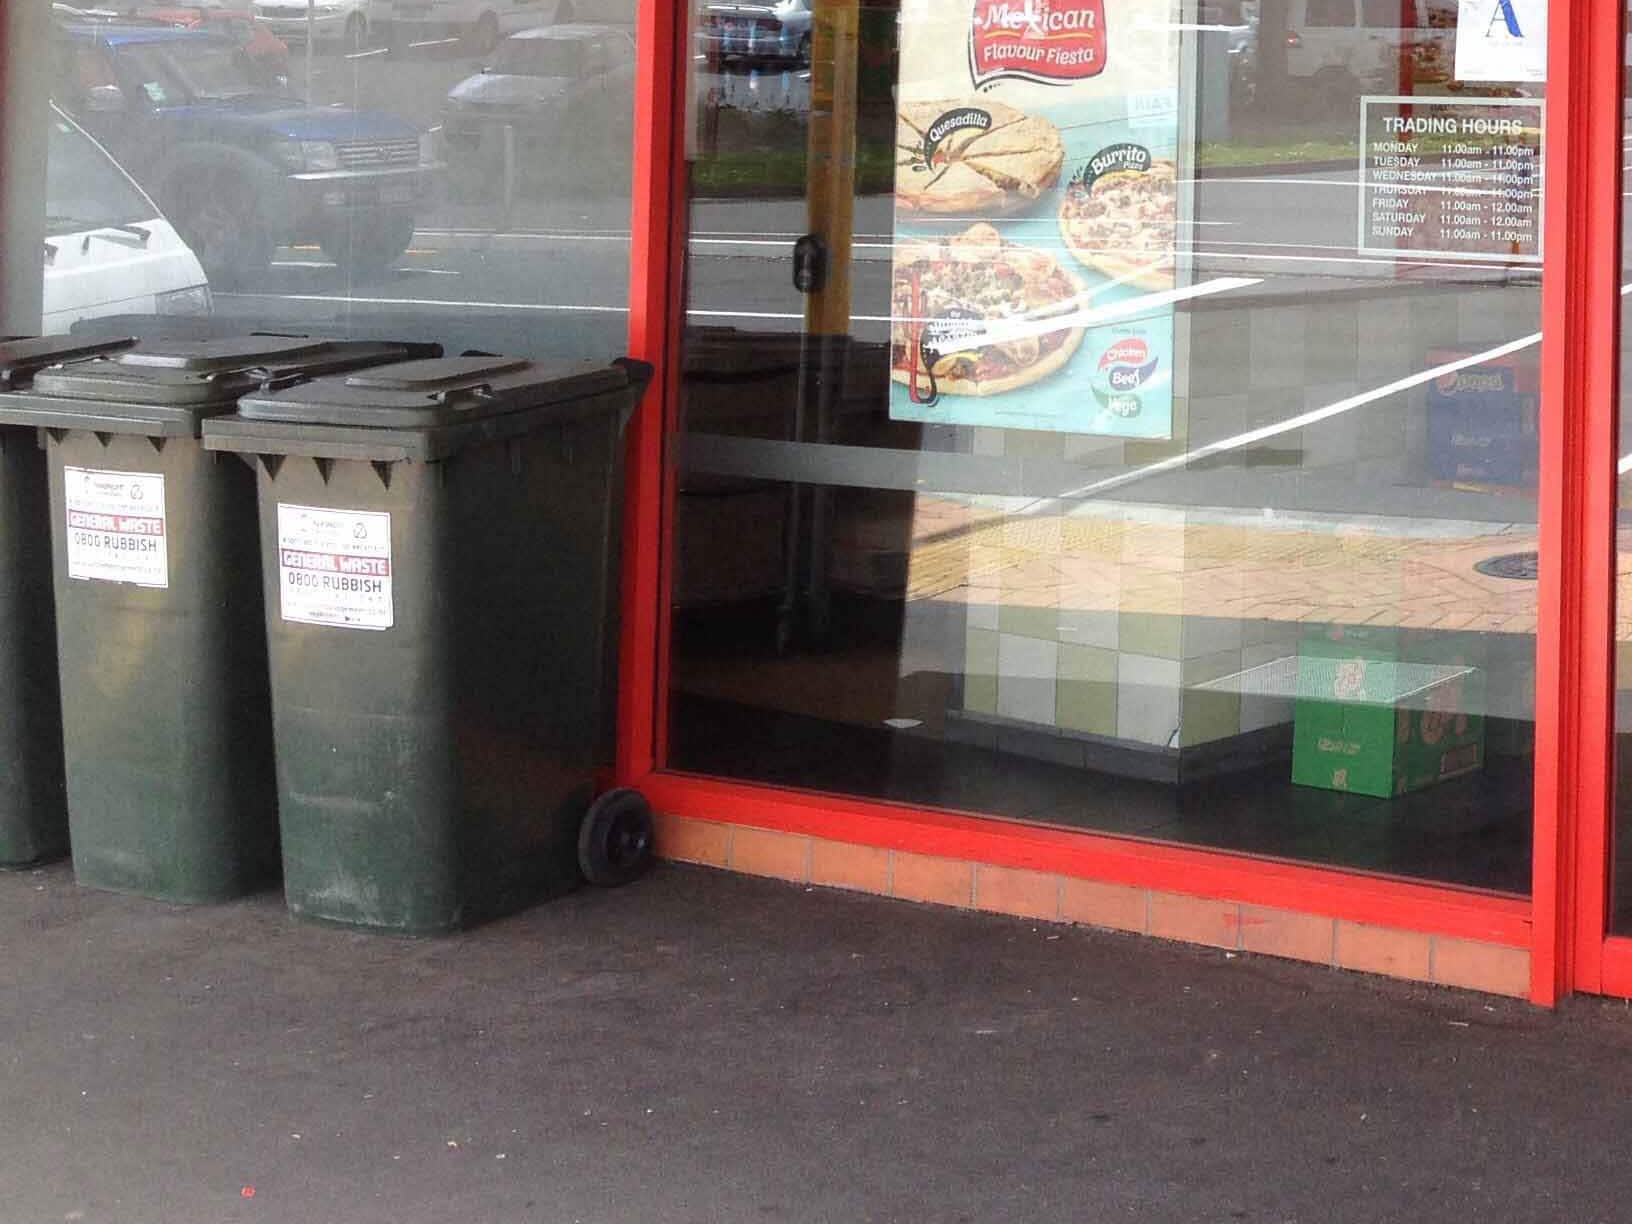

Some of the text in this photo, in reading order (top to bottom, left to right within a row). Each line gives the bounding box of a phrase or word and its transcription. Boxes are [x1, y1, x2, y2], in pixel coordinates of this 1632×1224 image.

[983, 42, 1094, 65] Flavour Fiesta
[929, 113, 988, 142] Quesadilla
[1384, 118, 1523, 135] TRADING HOURS
[1091, 147, 1146, 175] Burrito
[1374, 157, 1420, 167] TUESDAY
[1372, 199, 1409, 209] FRIDAY
[1372, 213, 1426, 223] SATURDAY
[1372, 226, 1414, 237] SUNDAY
[104, 536, 157, 552] RUBBISH
[340, 557, 388, 574] WASTE
[289, 572, 382, 593] 0800 RUBBISH
